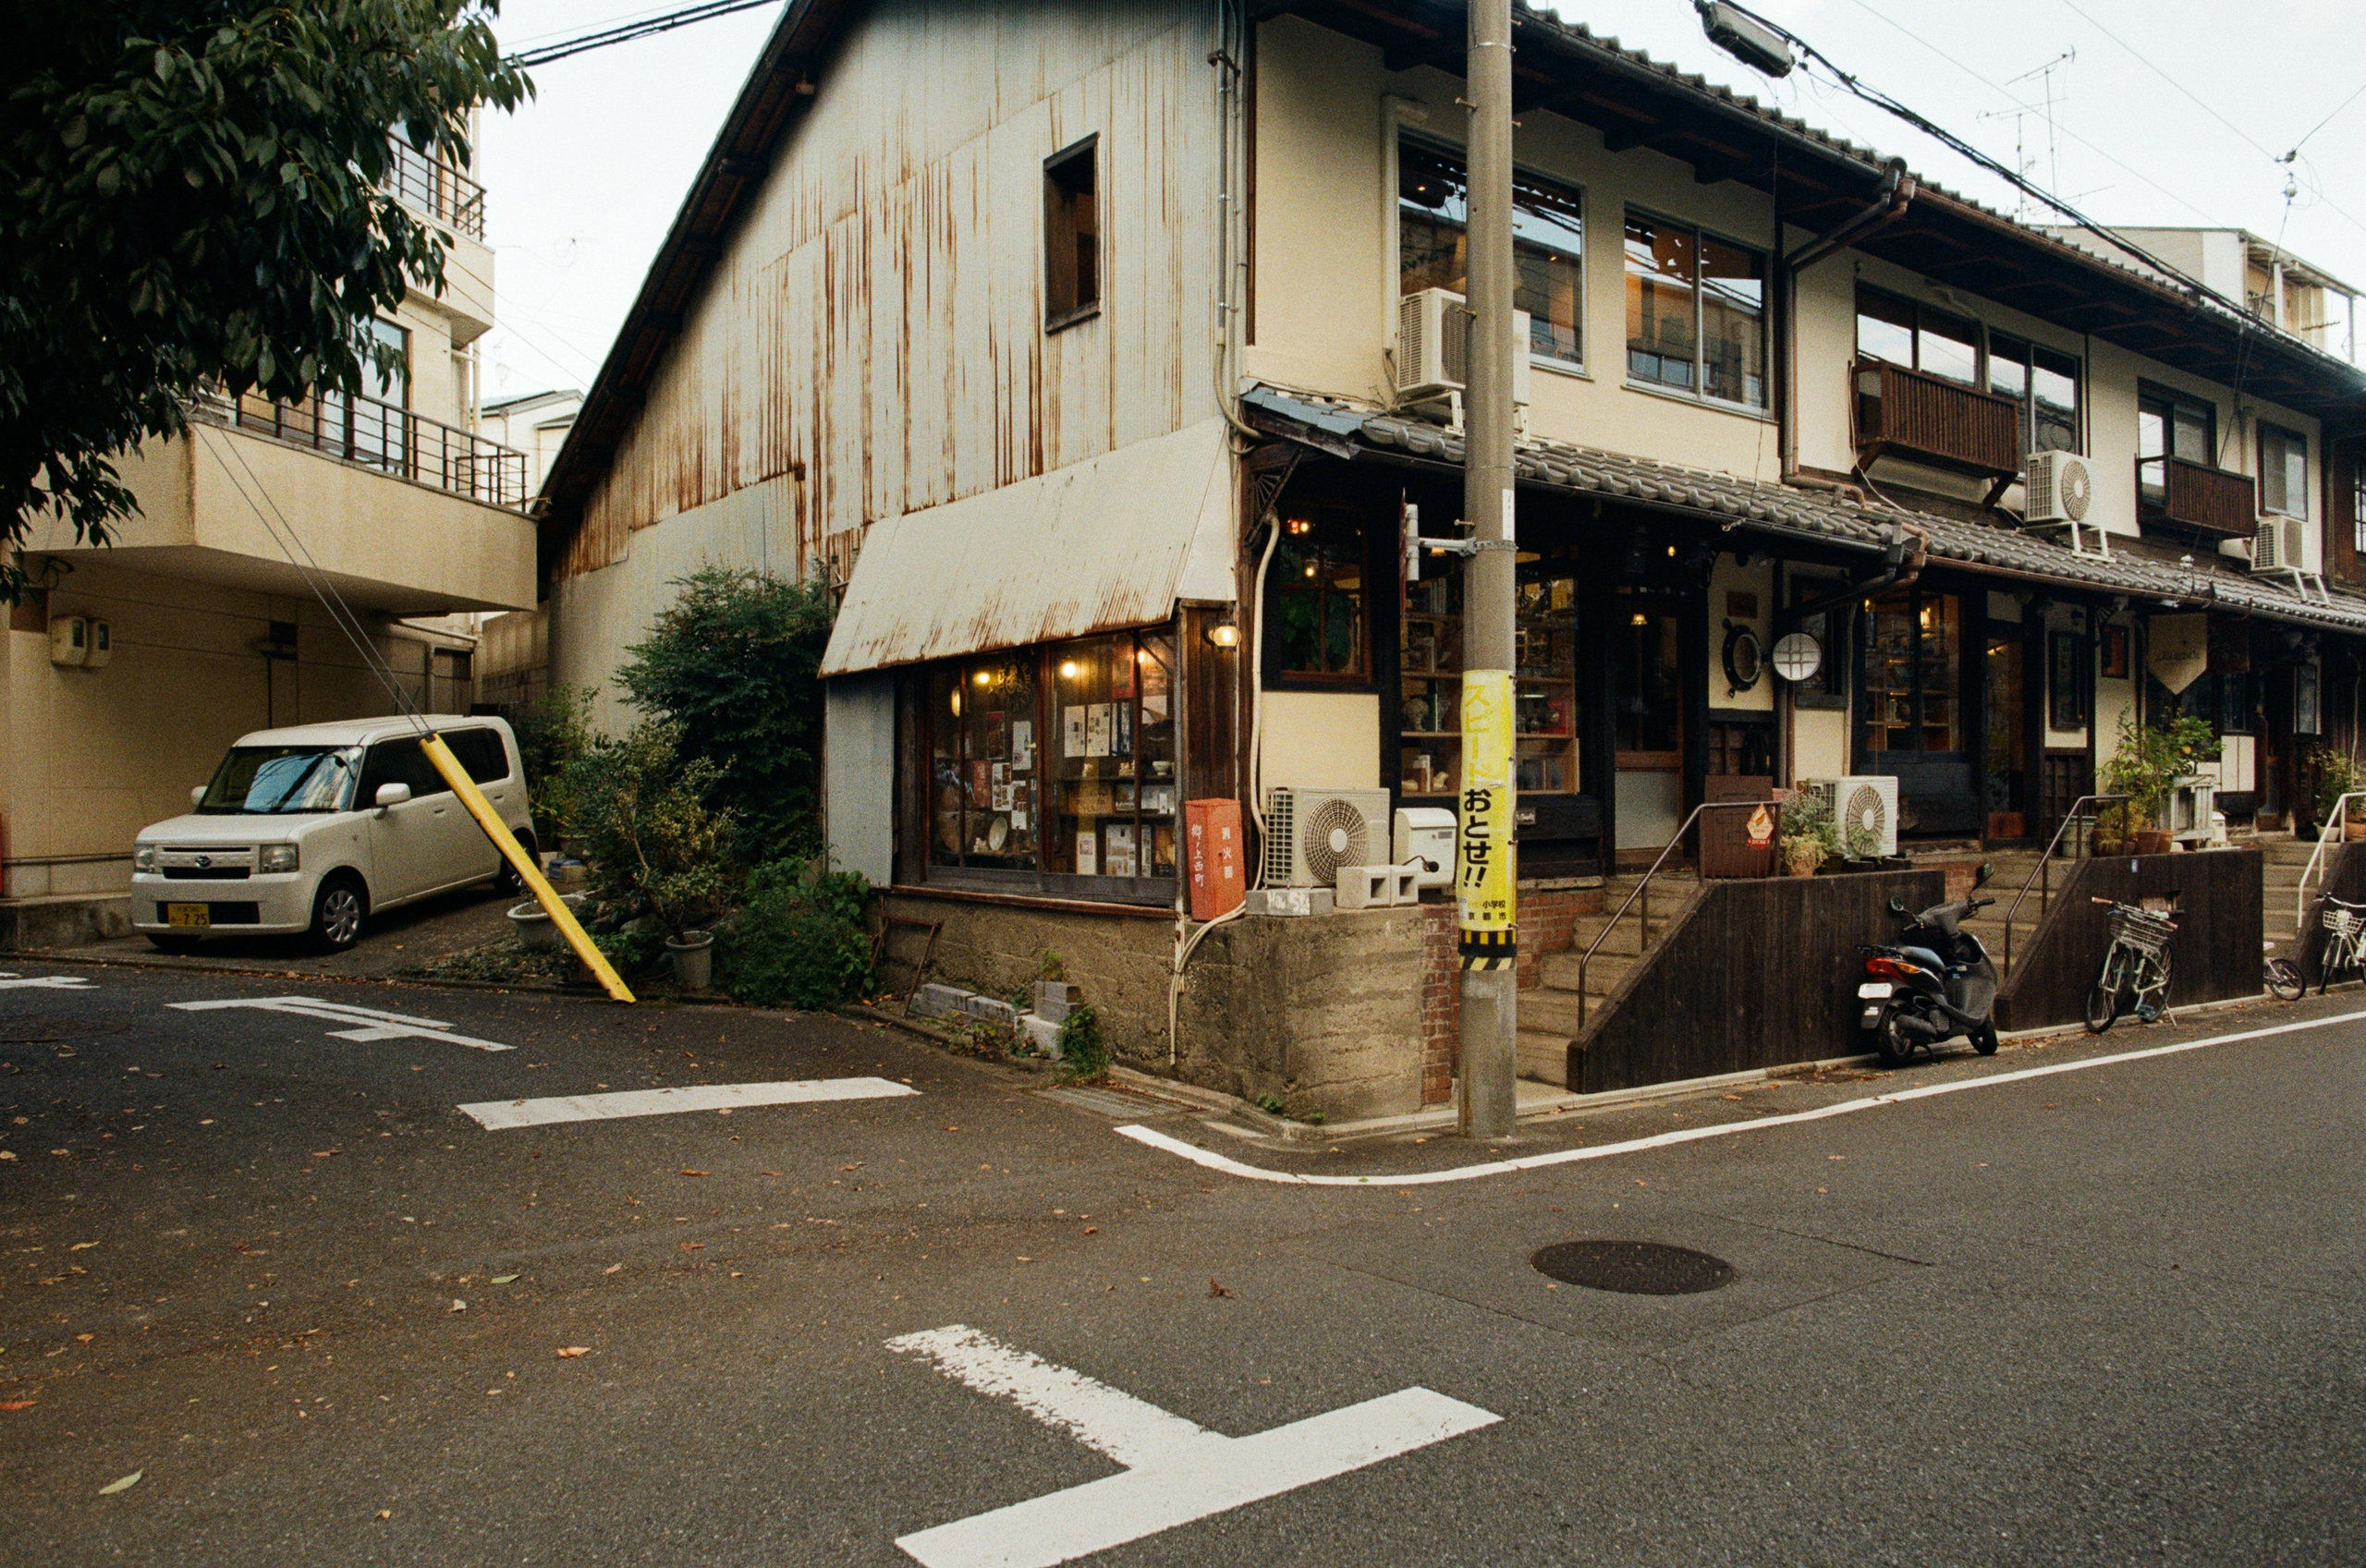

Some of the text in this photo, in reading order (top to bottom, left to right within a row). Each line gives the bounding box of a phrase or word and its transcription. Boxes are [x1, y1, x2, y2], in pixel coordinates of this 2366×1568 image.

[1222, 827, 1233, 879] 消火器
[1482, 899, 1506, 909] 小学校
